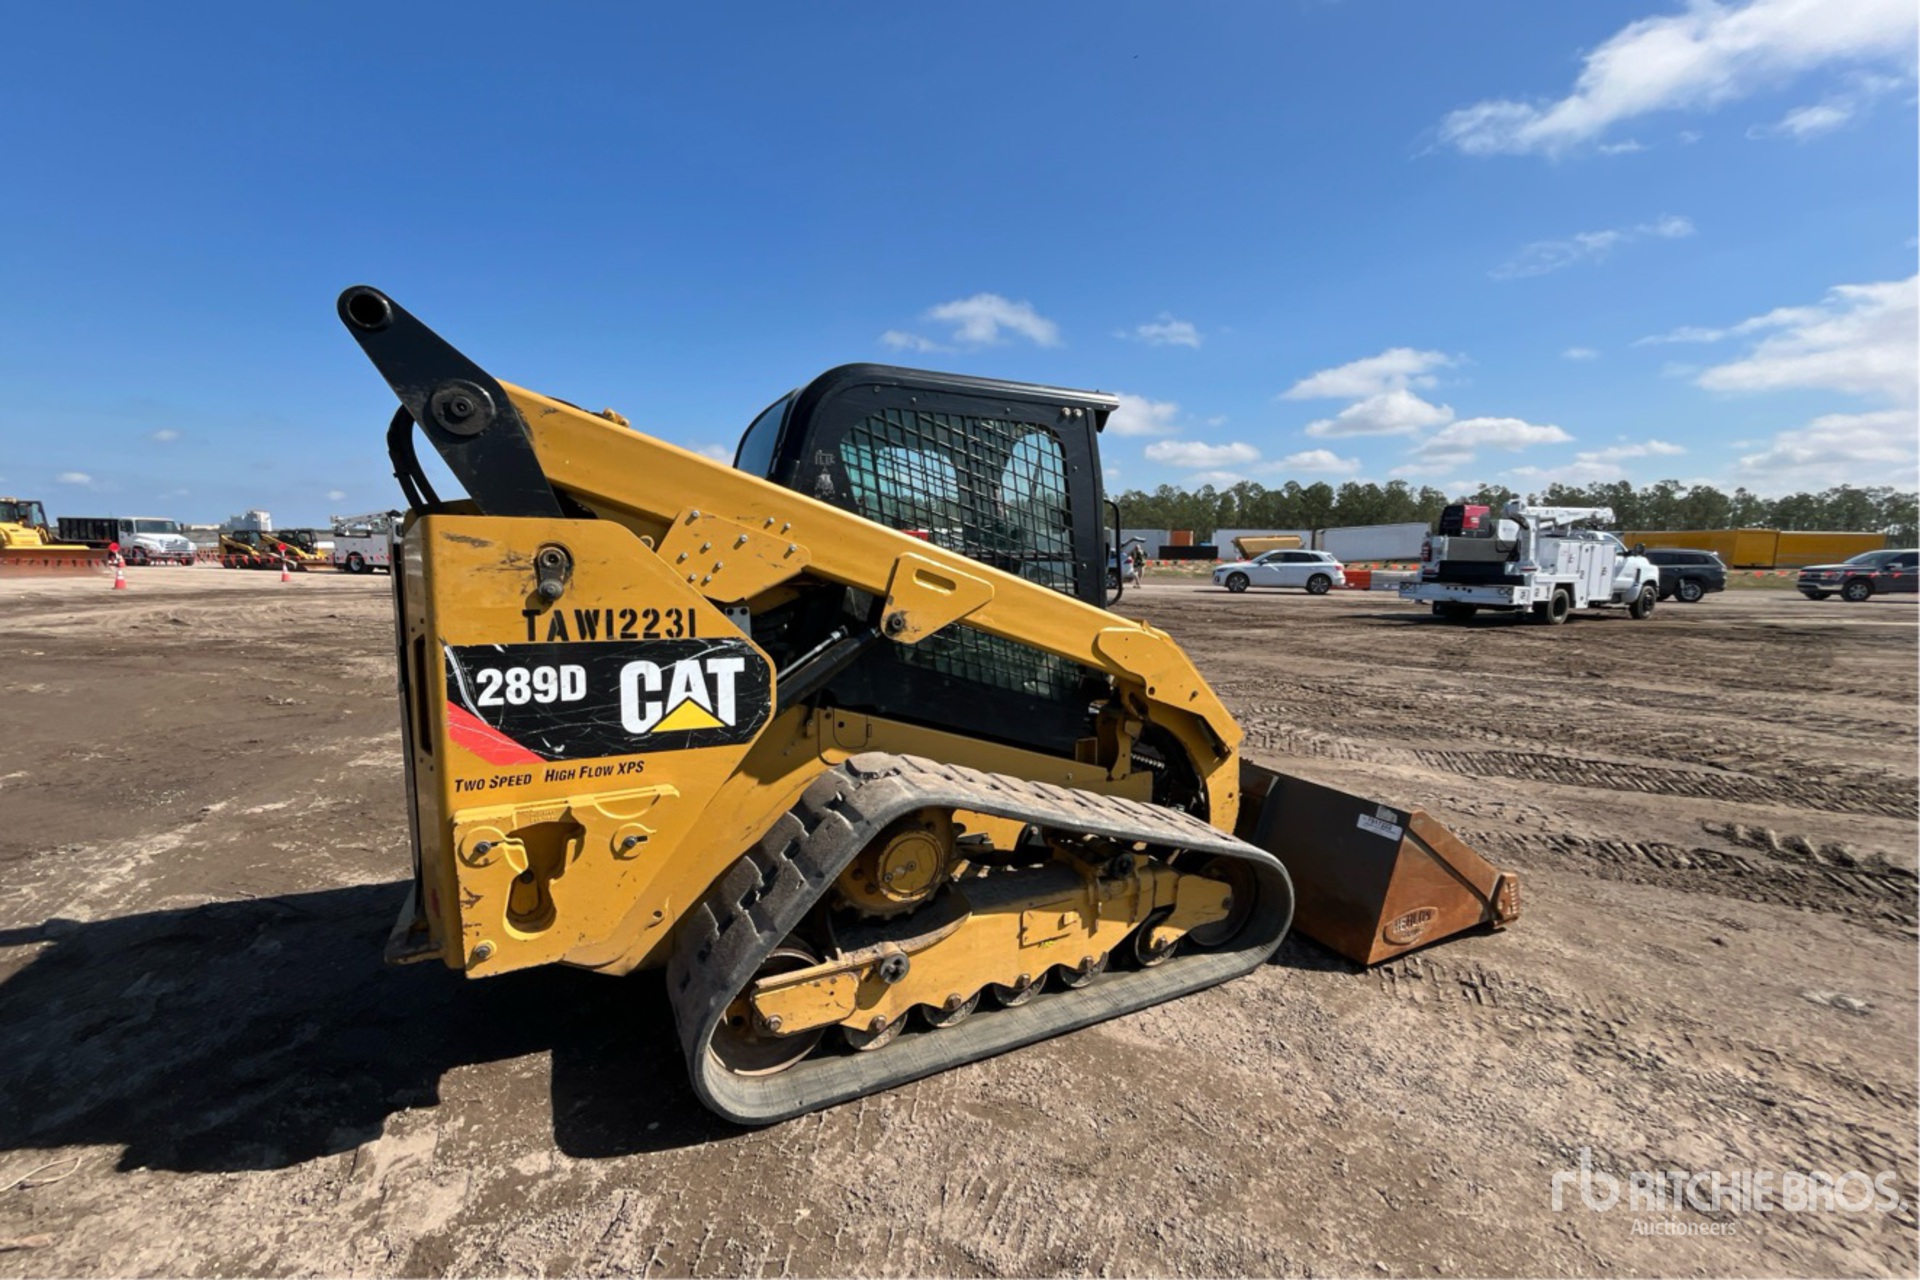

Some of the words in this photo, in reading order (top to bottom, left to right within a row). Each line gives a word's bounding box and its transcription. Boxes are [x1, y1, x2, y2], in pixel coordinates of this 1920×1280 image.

[476, 664, 588, 707] 289D
[620, 657, 745, 735] CAT
[617, 760, 645, 776] XPS
